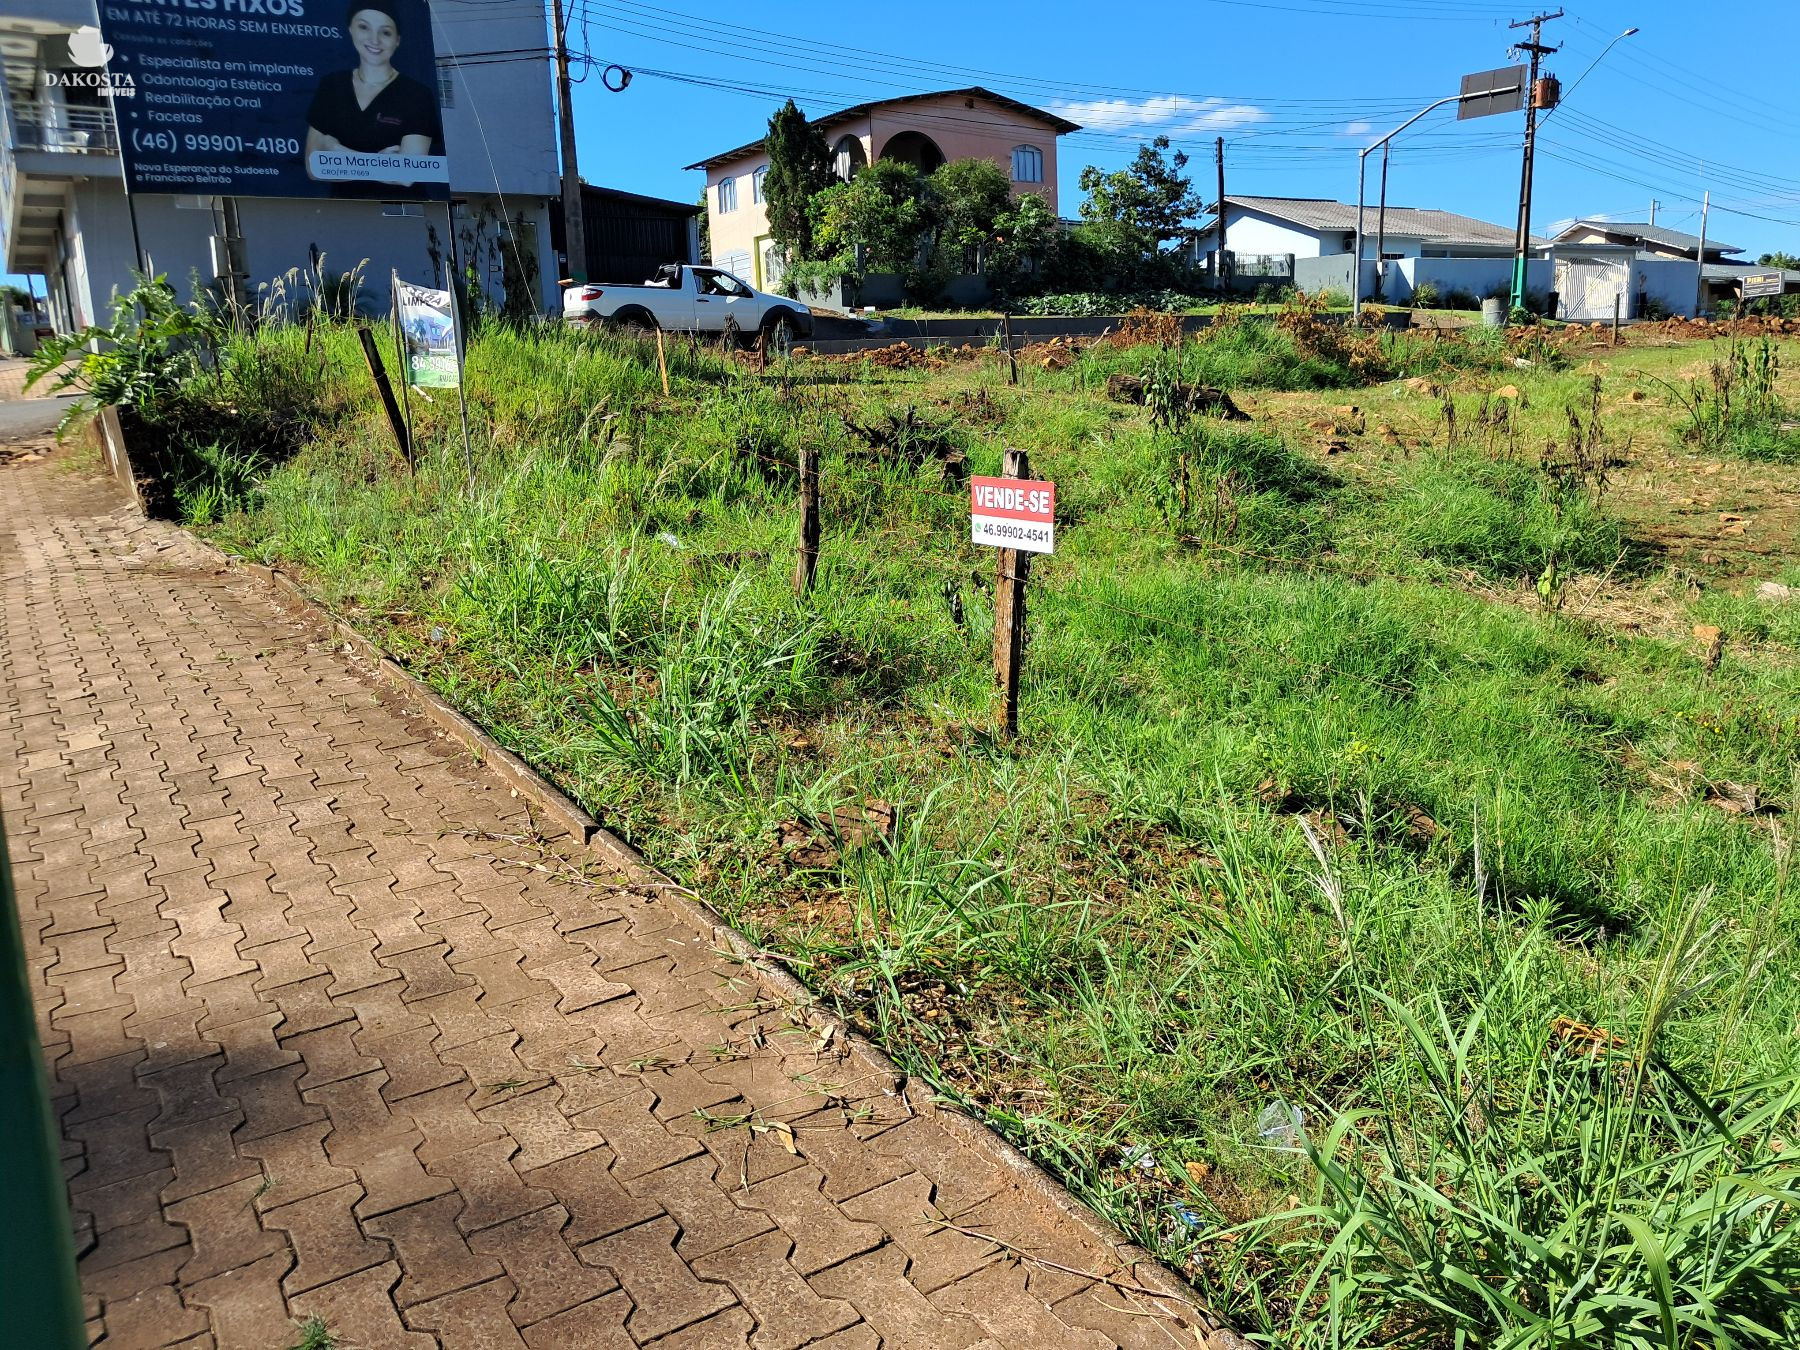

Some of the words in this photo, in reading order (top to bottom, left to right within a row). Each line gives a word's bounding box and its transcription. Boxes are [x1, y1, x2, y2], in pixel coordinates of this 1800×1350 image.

[106, 6, 130, 22] EM
[133, 8, 161, 25] ATÉ
[163, 11, 183, 27] 72
[185, 15, 236, 31] HORAS
[240, 19, 268, 33] SEM
[271, 22, 343, 39] ENXERTOS.
[138, 53, 221, 70] Especialista
[224, 61, 246, 72] em
[249, 61, 314, 76] implantes
[142, 73, 228, 91] Odontologia
[230, 78, 282, 92] Estética
[145, 91, 231, 109] Reabilitação
[234, 96, 261, 108] Oral
[148, 110, 203, 123] Facetas
[132, 128, 177, 153] (46)
[184, 134, 299, 154] 99901-4180
[134, 163, 161, 172] Nova
[163, 164, 217, 176] Esperança
[218, 166, 232, 174] do
[234, 166, 279, 176] Sudoeste
[319, 154, 342, 166] Dra
[345, 156, 400, 168] Marciela
[404, 158, 440, 170] Ruaro
[145, 174, 194, 183] Francisco
[196, 175, 232, 184] Beltrão
[975, 485, 1050, 515] VENDE-SE
[983, 523, 1049, 543] 46.99902-4541
